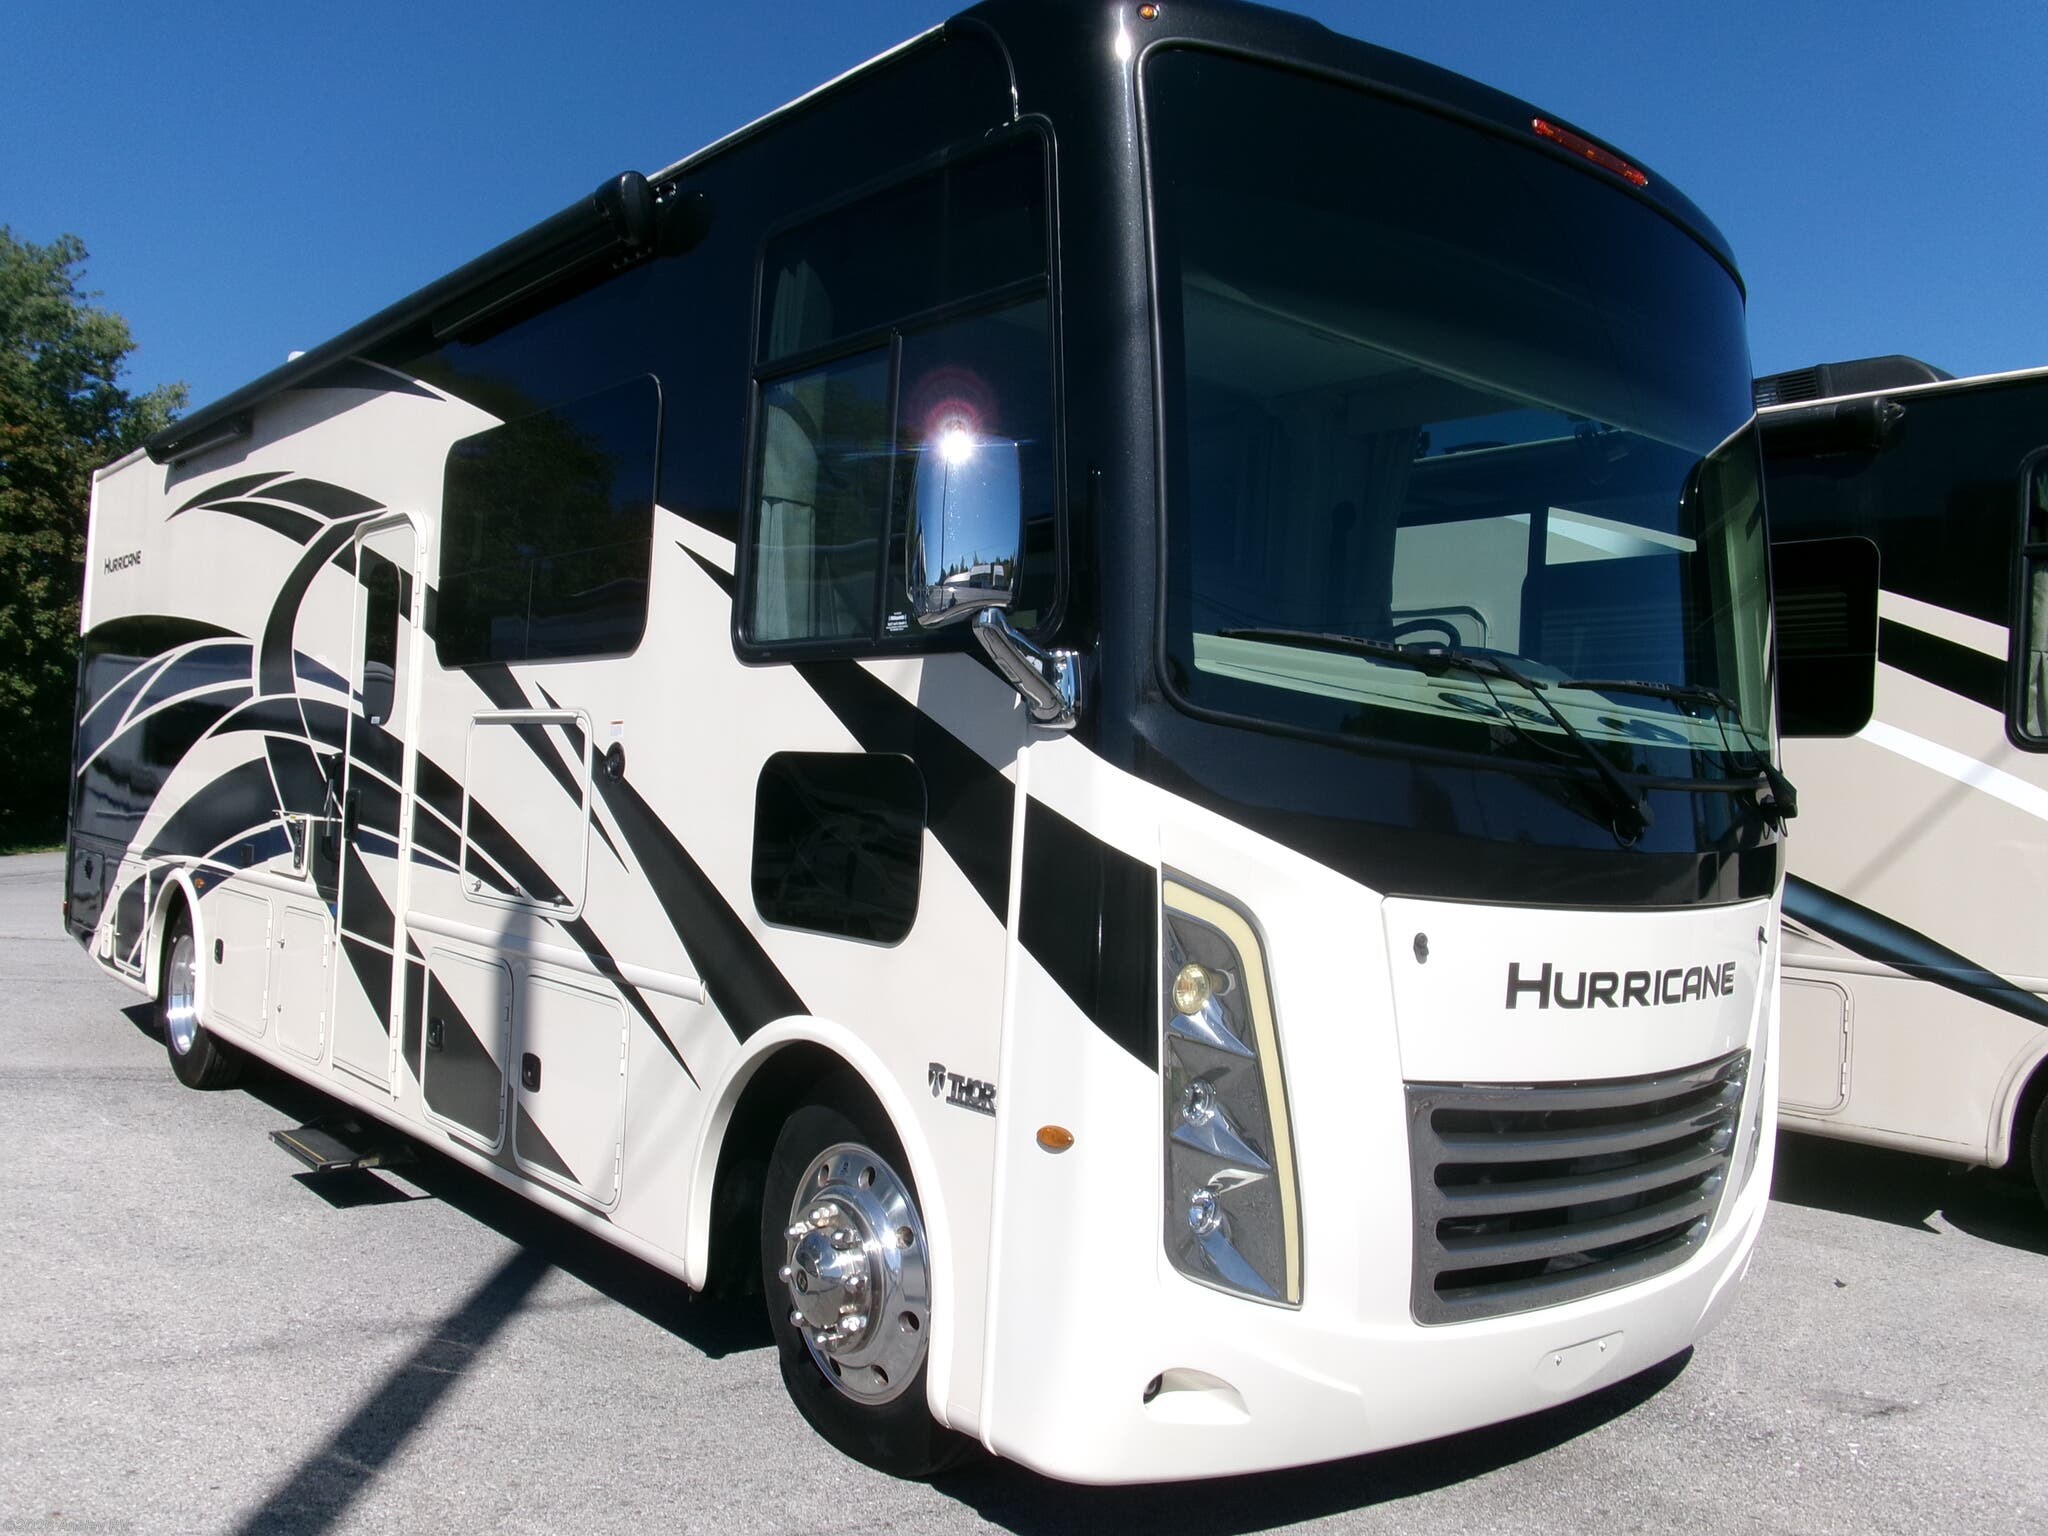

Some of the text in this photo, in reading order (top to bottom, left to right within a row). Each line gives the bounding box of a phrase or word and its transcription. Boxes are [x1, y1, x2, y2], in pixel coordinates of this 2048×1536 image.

[103, 549, 141, 575] HURRICANE
[1505, 961, 1736, 1009] HURRICANE
[946, 1072, 996, 1108] THOR
